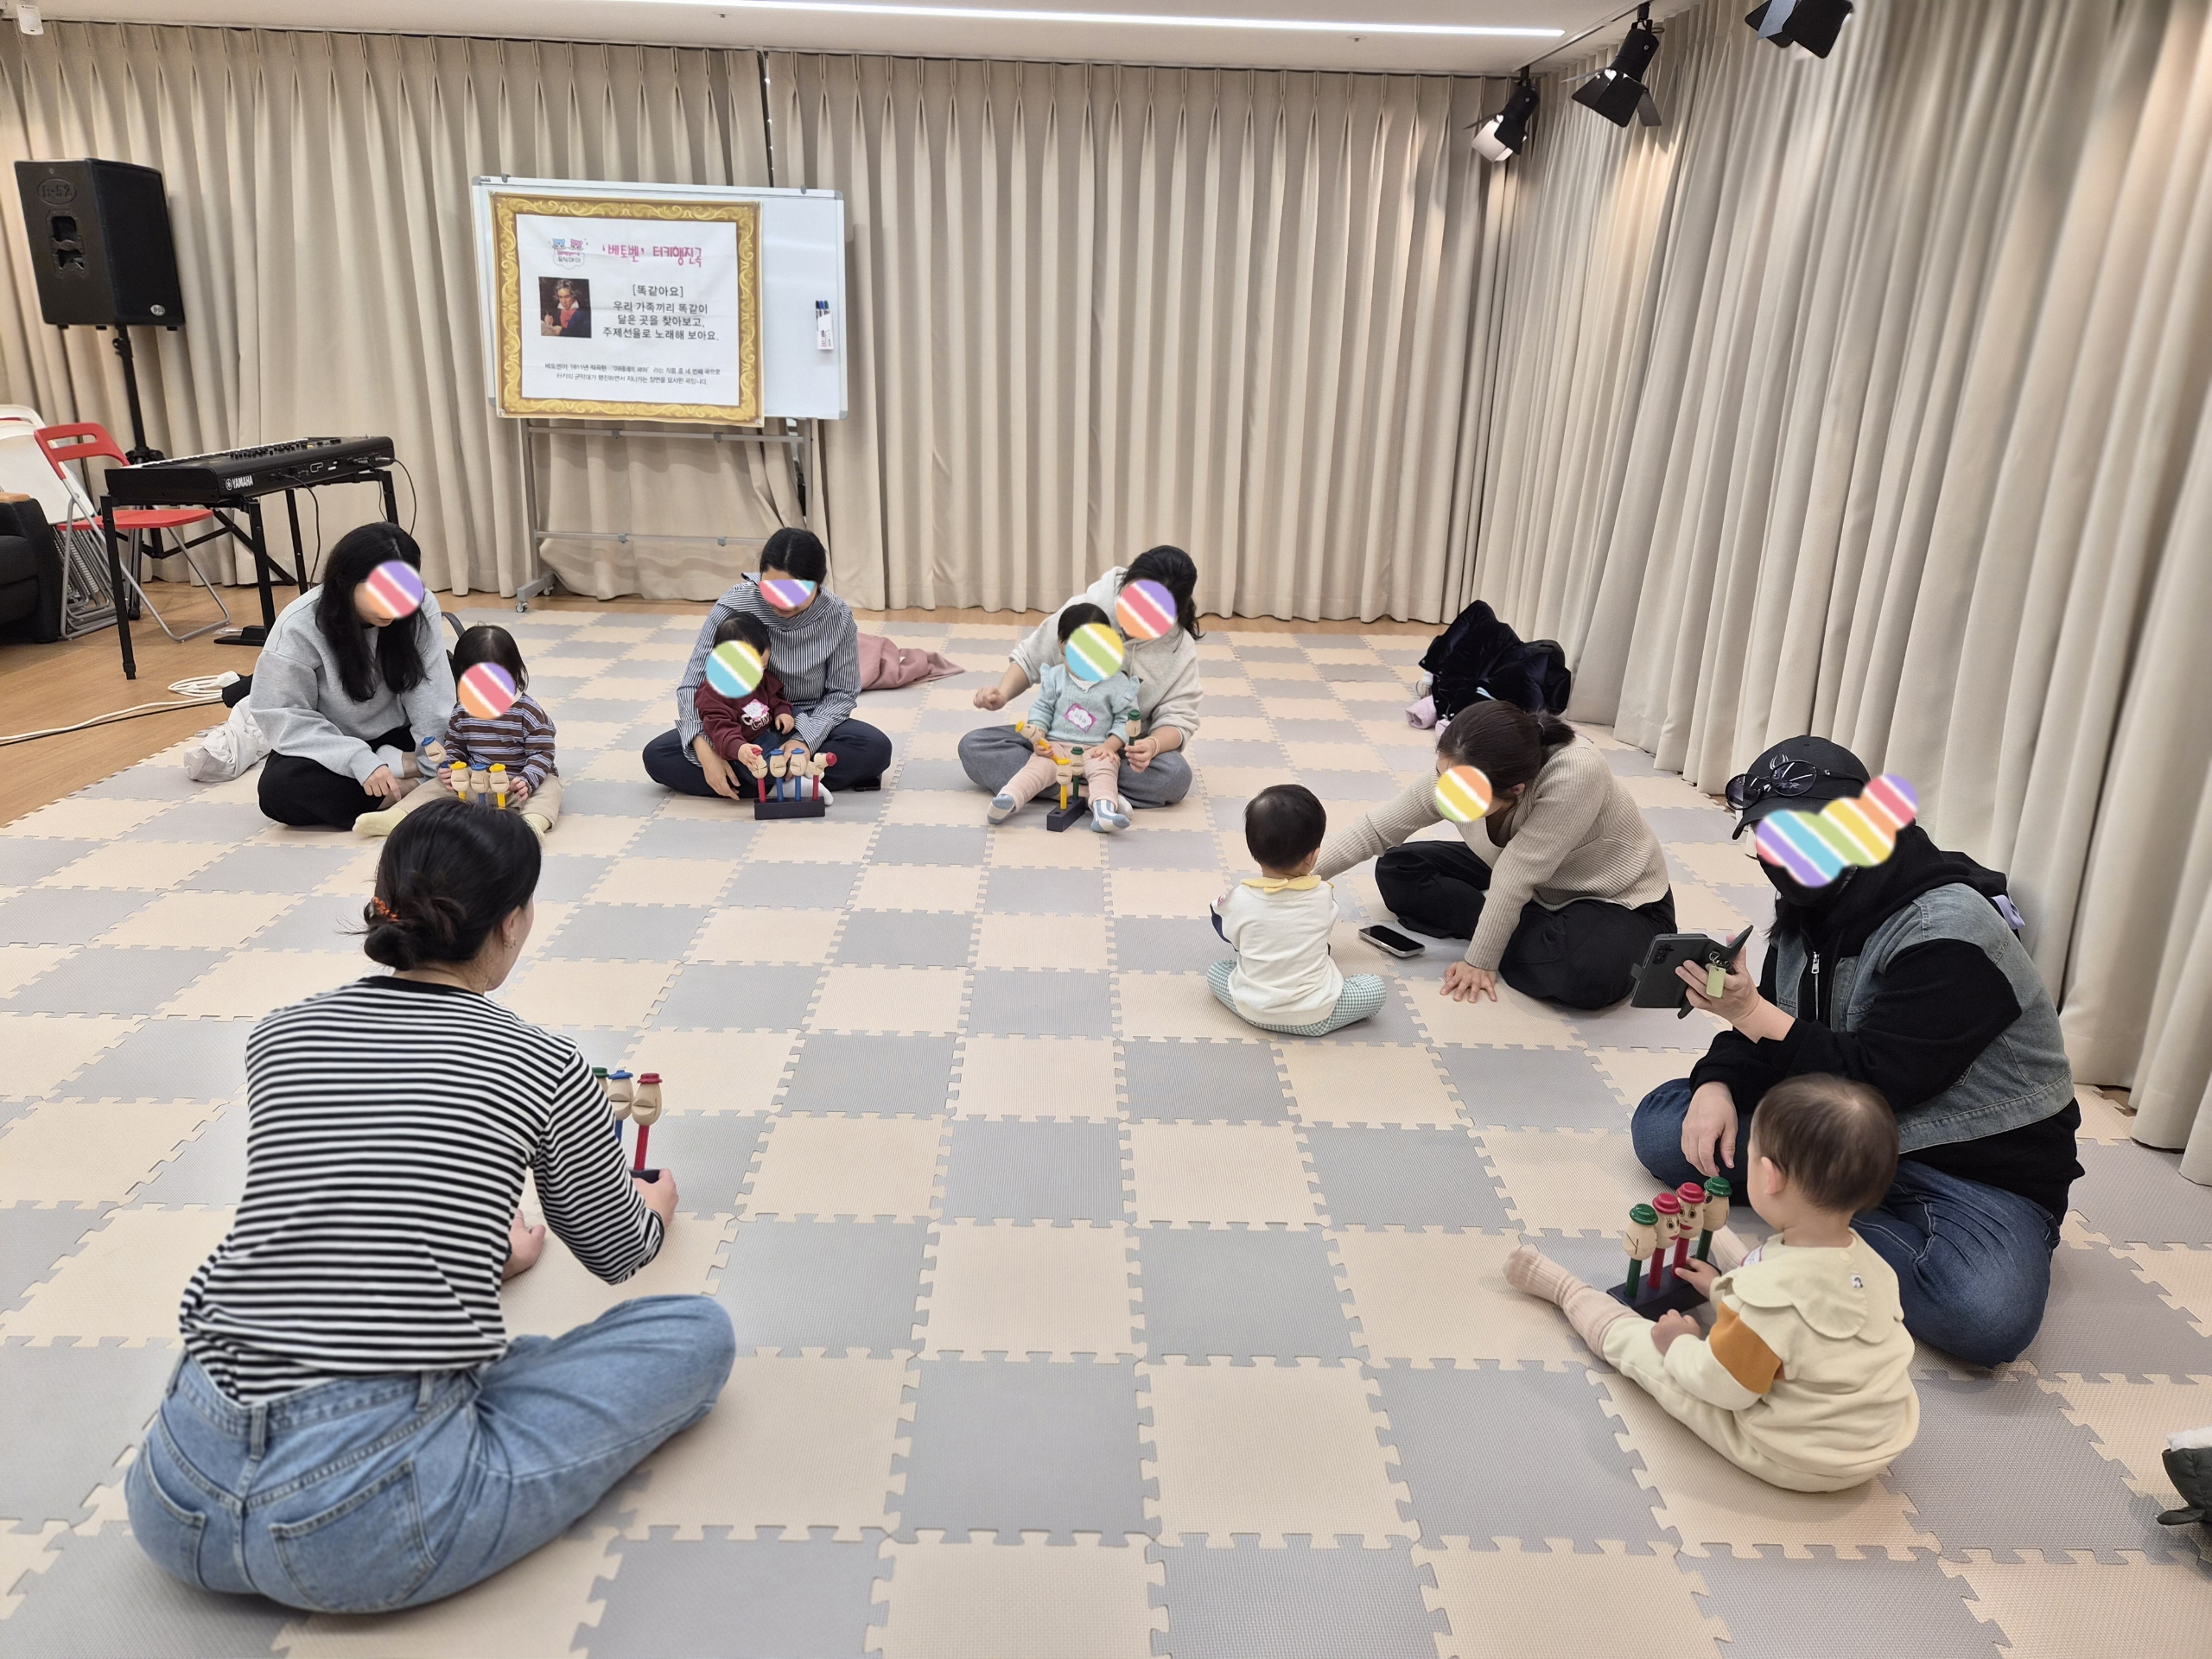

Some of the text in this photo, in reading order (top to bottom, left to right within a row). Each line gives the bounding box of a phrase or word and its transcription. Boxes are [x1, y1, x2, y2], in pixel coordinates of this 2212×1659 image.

[652, 246, 702, 267] 터키행진곡
[632, 284, 683, 297] [똑같아요]
[613, 301, 708, 314] 우리 가족끼리 똑같이
[618, 315, 705, 327] 닮은 곳을 찾아보고,
[602, 327, 719, 340] 주제선율로 노래해 보아요.
[232, 475, 254, 489] YAMAHA
